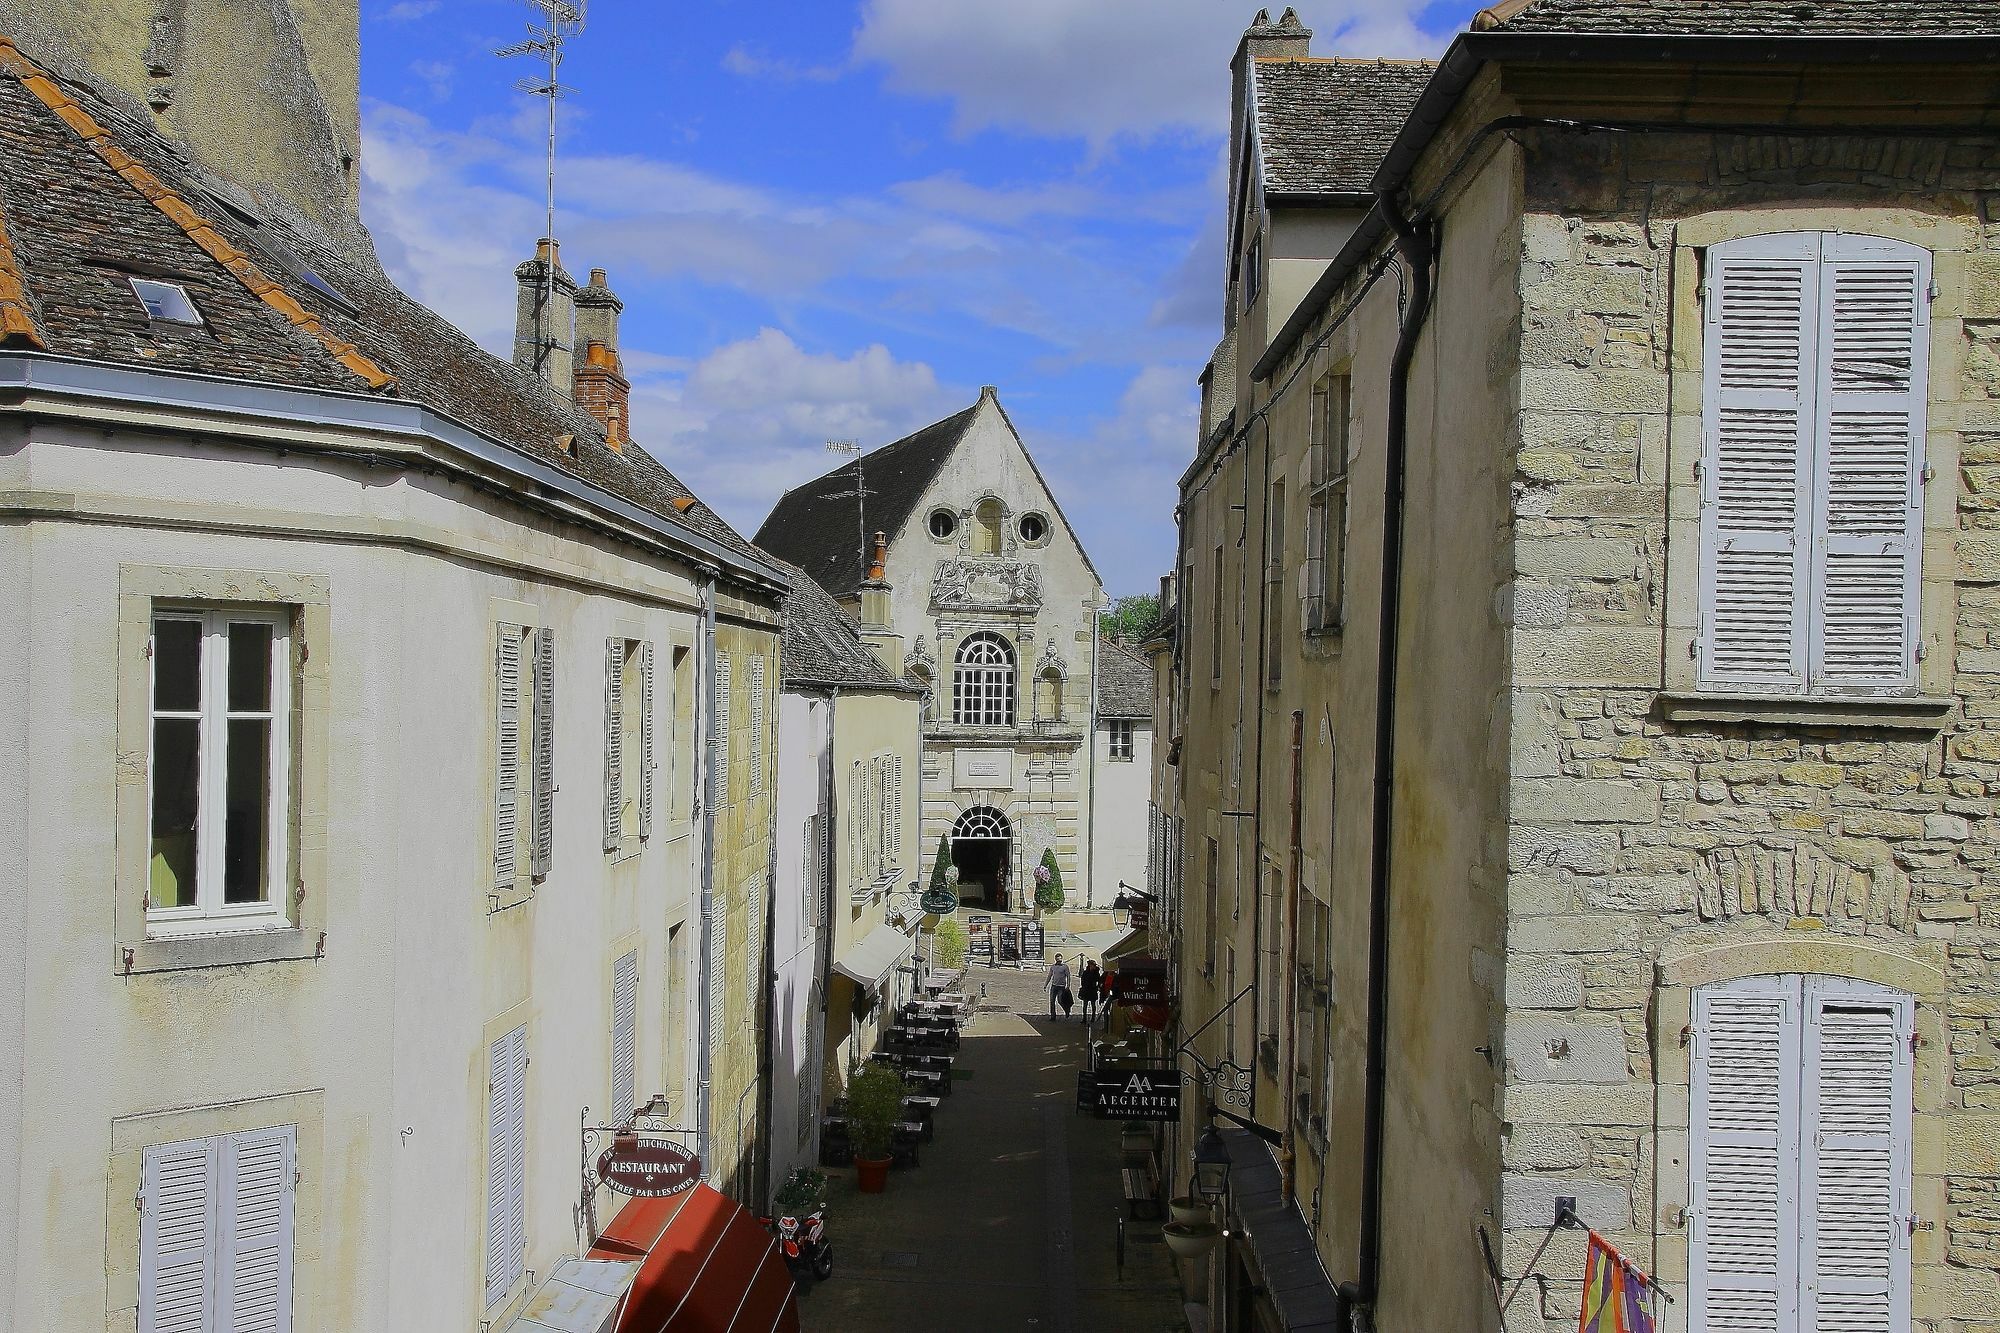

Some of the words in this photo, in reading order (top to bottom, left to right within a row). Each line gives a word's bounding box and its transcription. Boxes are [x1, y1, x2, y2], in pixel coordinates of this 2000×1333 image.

[1133, 977, 1150, 985] Pub
[1123, 991, 1144, 1000] Wine
[1145, 992, 1160, 1000] Bar
[1098, 1093, 1178, 1107] AEGERTER
[603, 1149, 614, 1161] LA
[637, 1139, 649, 1148] DU
[650, 1140, 693, 1162] CHANCELIER
[610, 1162, 686, 1174] RESTAURANT
[635, 1189, 654, 1197] PAR
[656, 1188, 672, 1197] LES
[672, 1176, 695, 1193] CAVES
